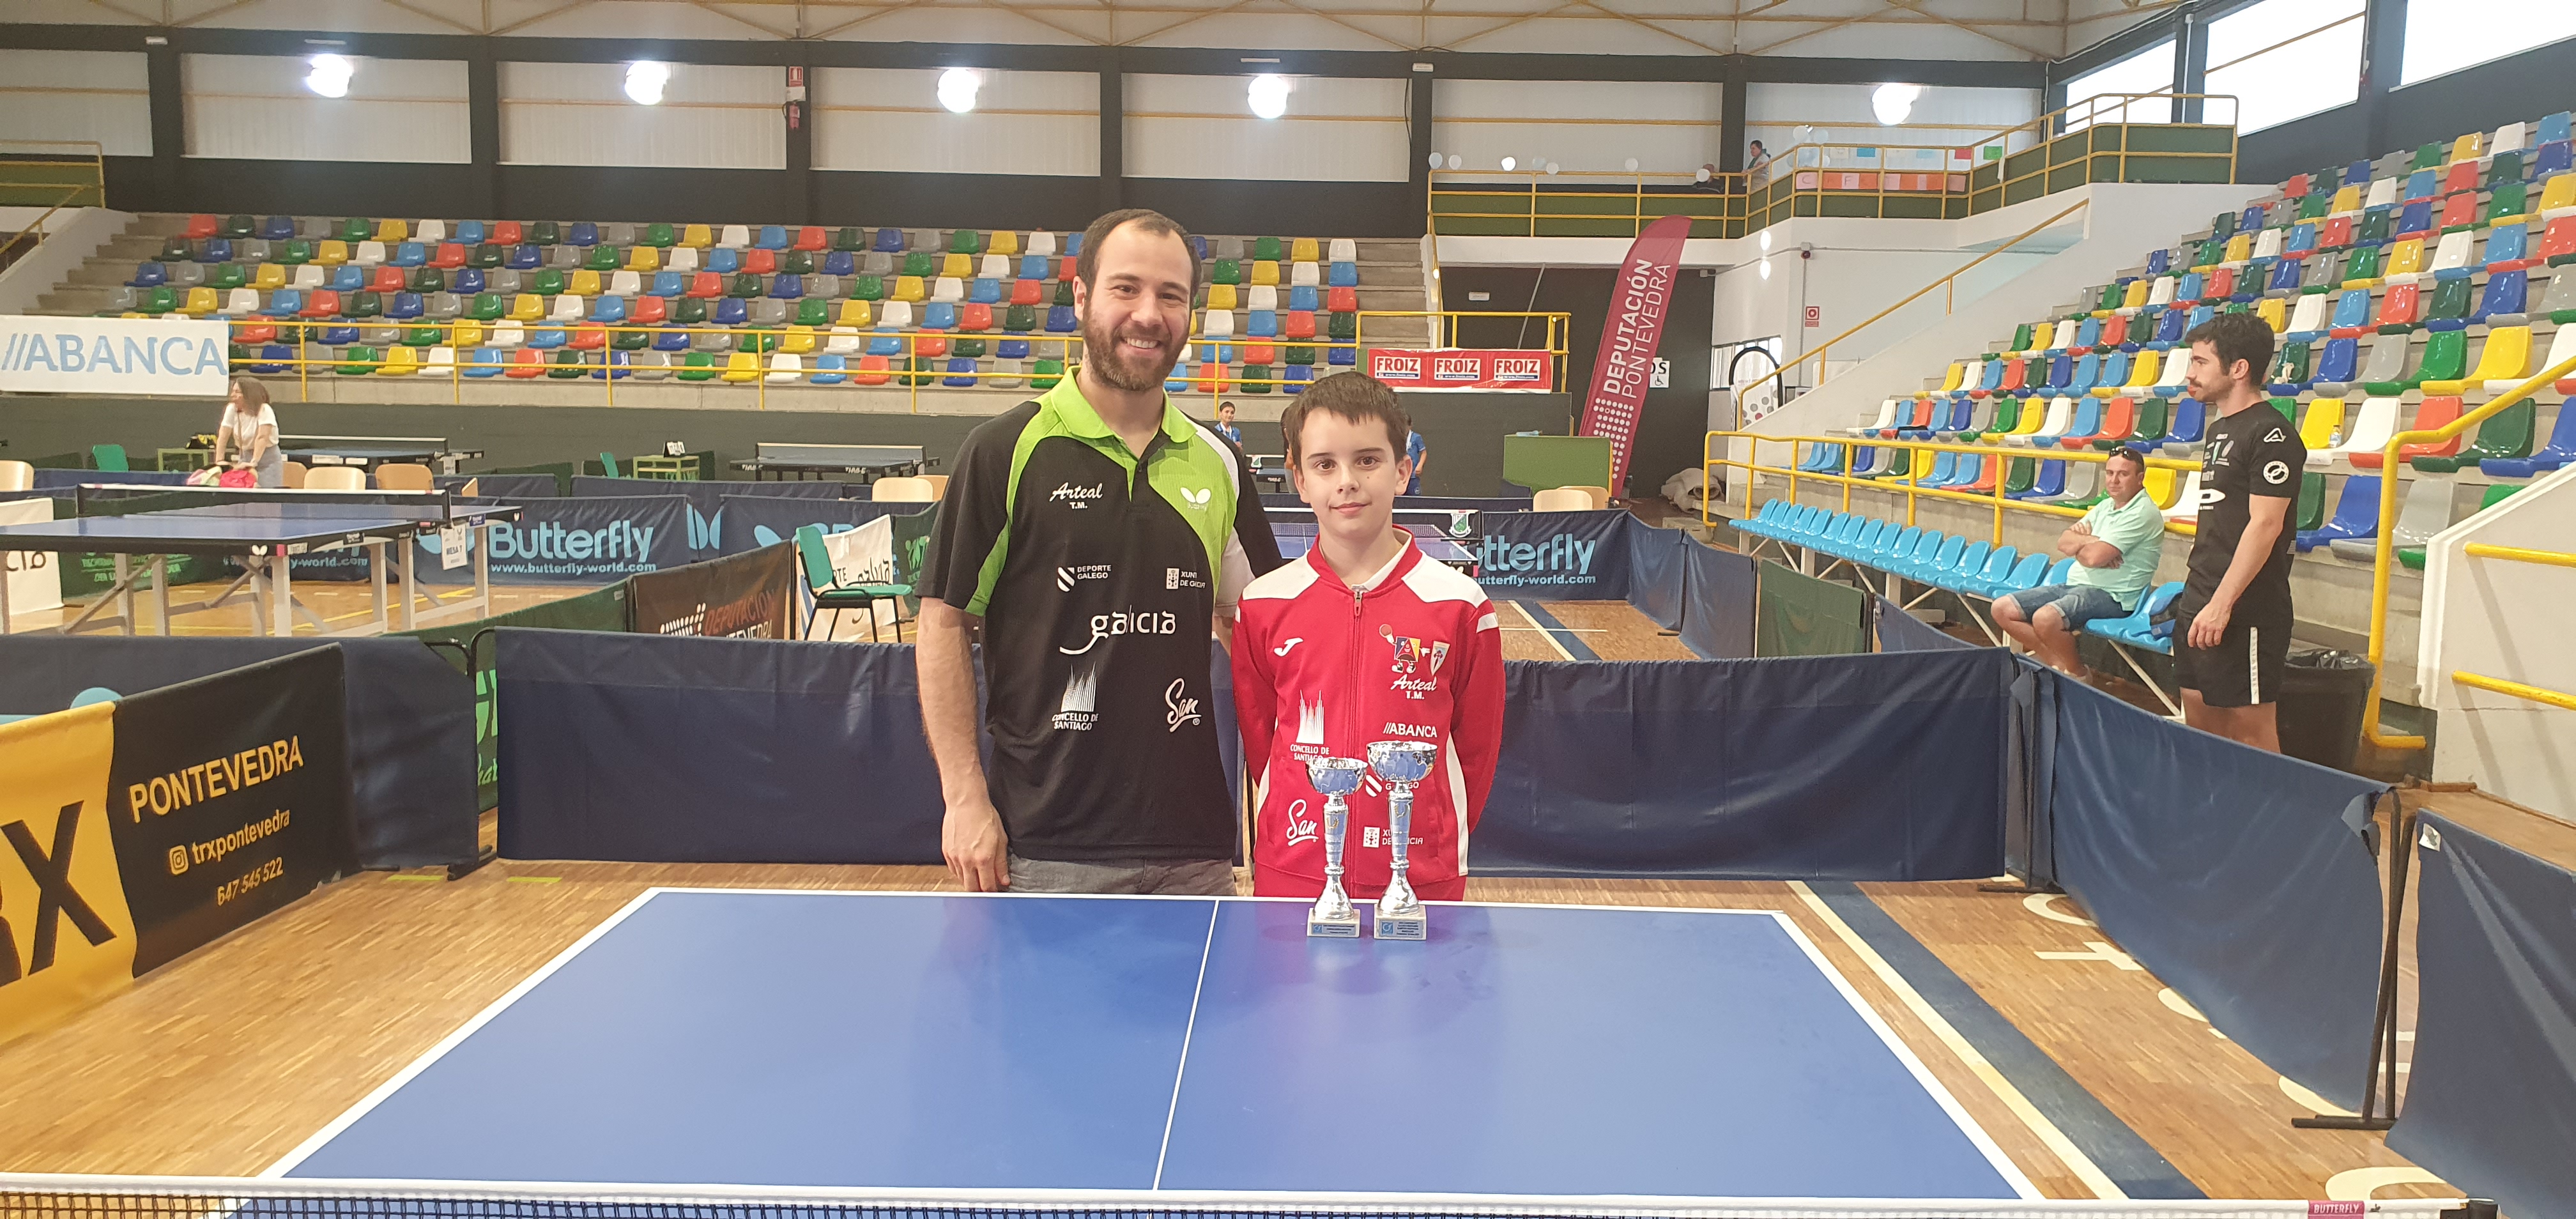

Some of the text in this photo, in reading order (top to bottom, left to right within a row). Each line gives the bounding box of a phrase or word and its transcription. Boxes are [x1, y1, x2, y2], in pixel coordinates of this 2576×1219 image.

[1603, 259, 1653, 394] DEPUTACIÓN
[1621, 264, 1671, 399] PONTEVEDRA
[1377, 358, 1418, 372] FROIZ
[1436, 359, 1478, 373] FROIZ
[1496, 360, 1538, 374] FROIZ
[1049, 482, 1103, 502] Arteal
[1070, 502, 1088, 510] T.M.
[489, 520, 654, 563] Butterfly
[491, 562, 657, 576] www.butterfly-world.com
[1077, 565, 1112, 573] DEPORTE
[1077, 572, 1108, 580] GALEGO
[1390, 674, 1438, 691] Arteal
[1406, 691, 1425, 700] T.M.
[1052, 712, 1089, 723] CONCELLO
[1054, 721, 1092, 731] SANTIAGO
[1290, 744, 1330, 755] CONCELLO DE
[129, 735, 304, 824] PONTEVEDRA
[192, 809, 291, 864] trxpontevedra
[217, 856, 284, 906] 647 545 522
[2313, 1203, 2360, 1214] BUTTERFLY
